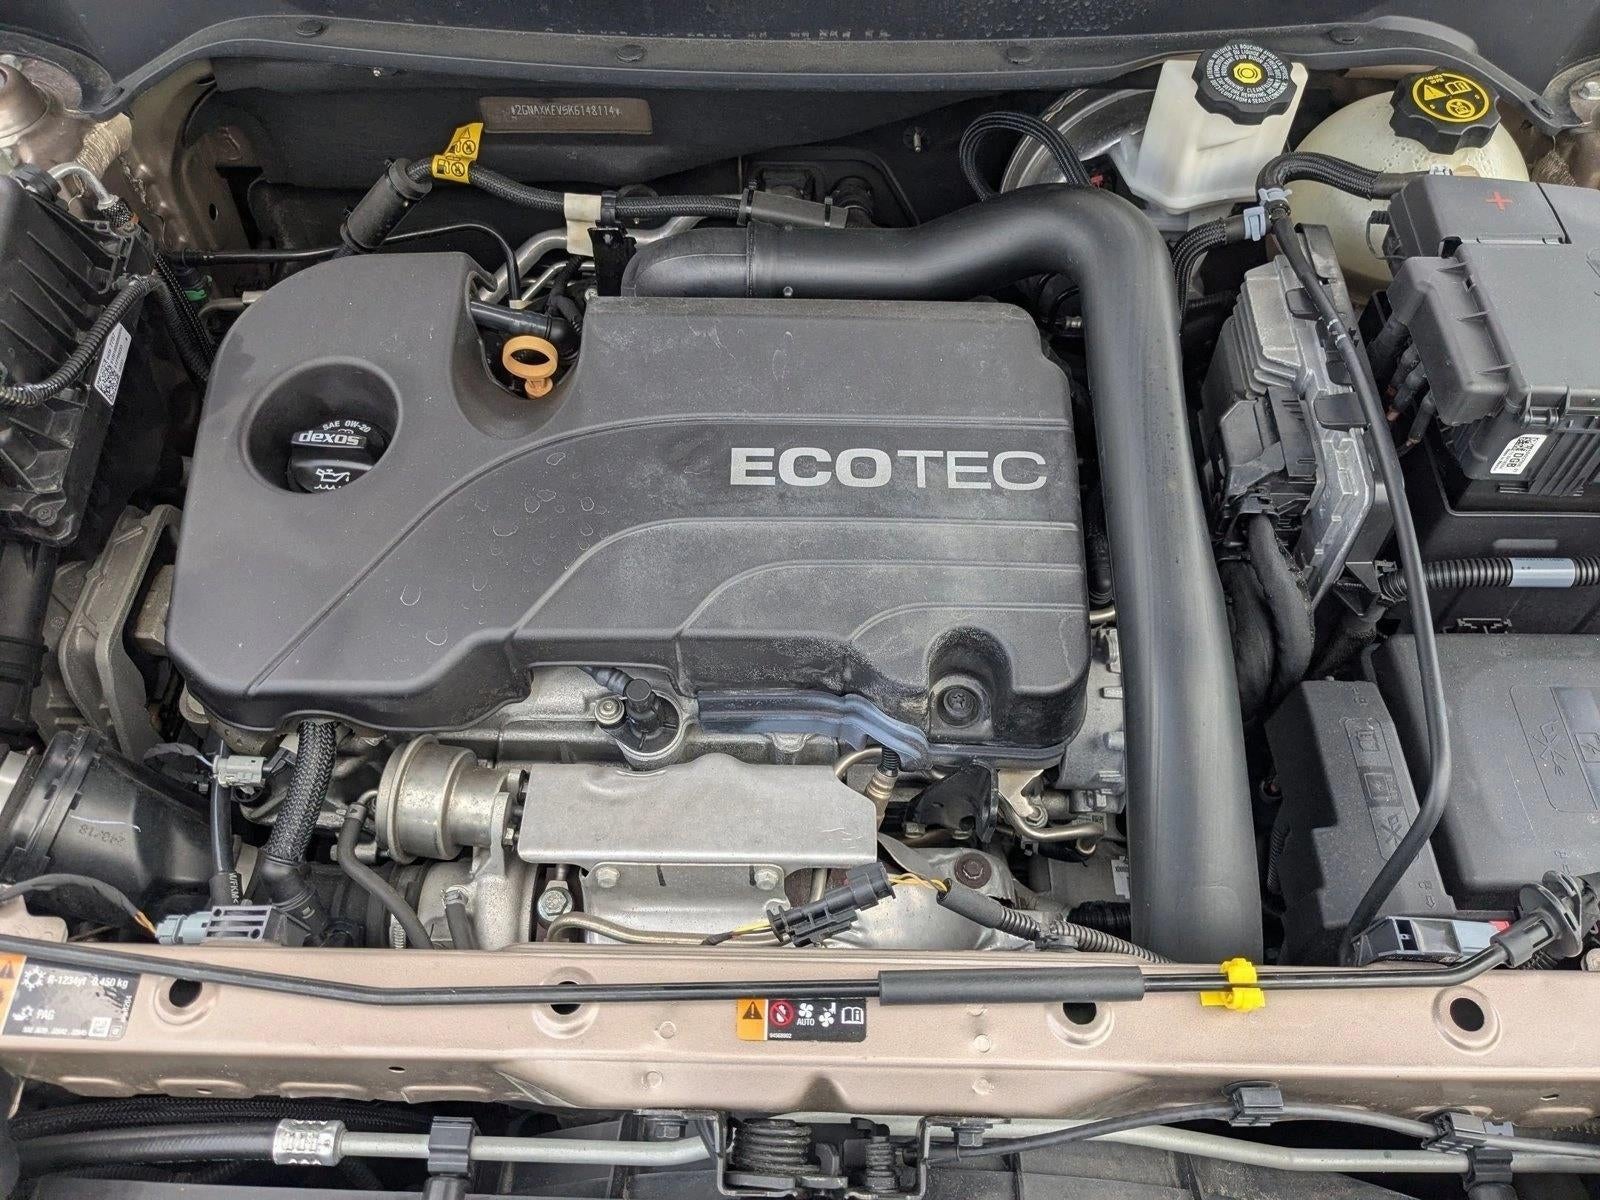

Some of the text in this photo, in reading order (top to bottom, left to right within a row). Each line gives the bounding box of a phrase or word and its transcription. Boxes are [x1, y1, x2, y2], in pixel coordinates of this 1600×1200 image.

[322, 419, 371, 433] SAE 0W-20
[298, 430, 360, 446] dexos
[730, 446, 1048, 491] ECOTEC
[116, 977, 129, 989] kg
[36, 1009, 56, 1020] PAG
[796, 1017, 815, 1026] AUTO
